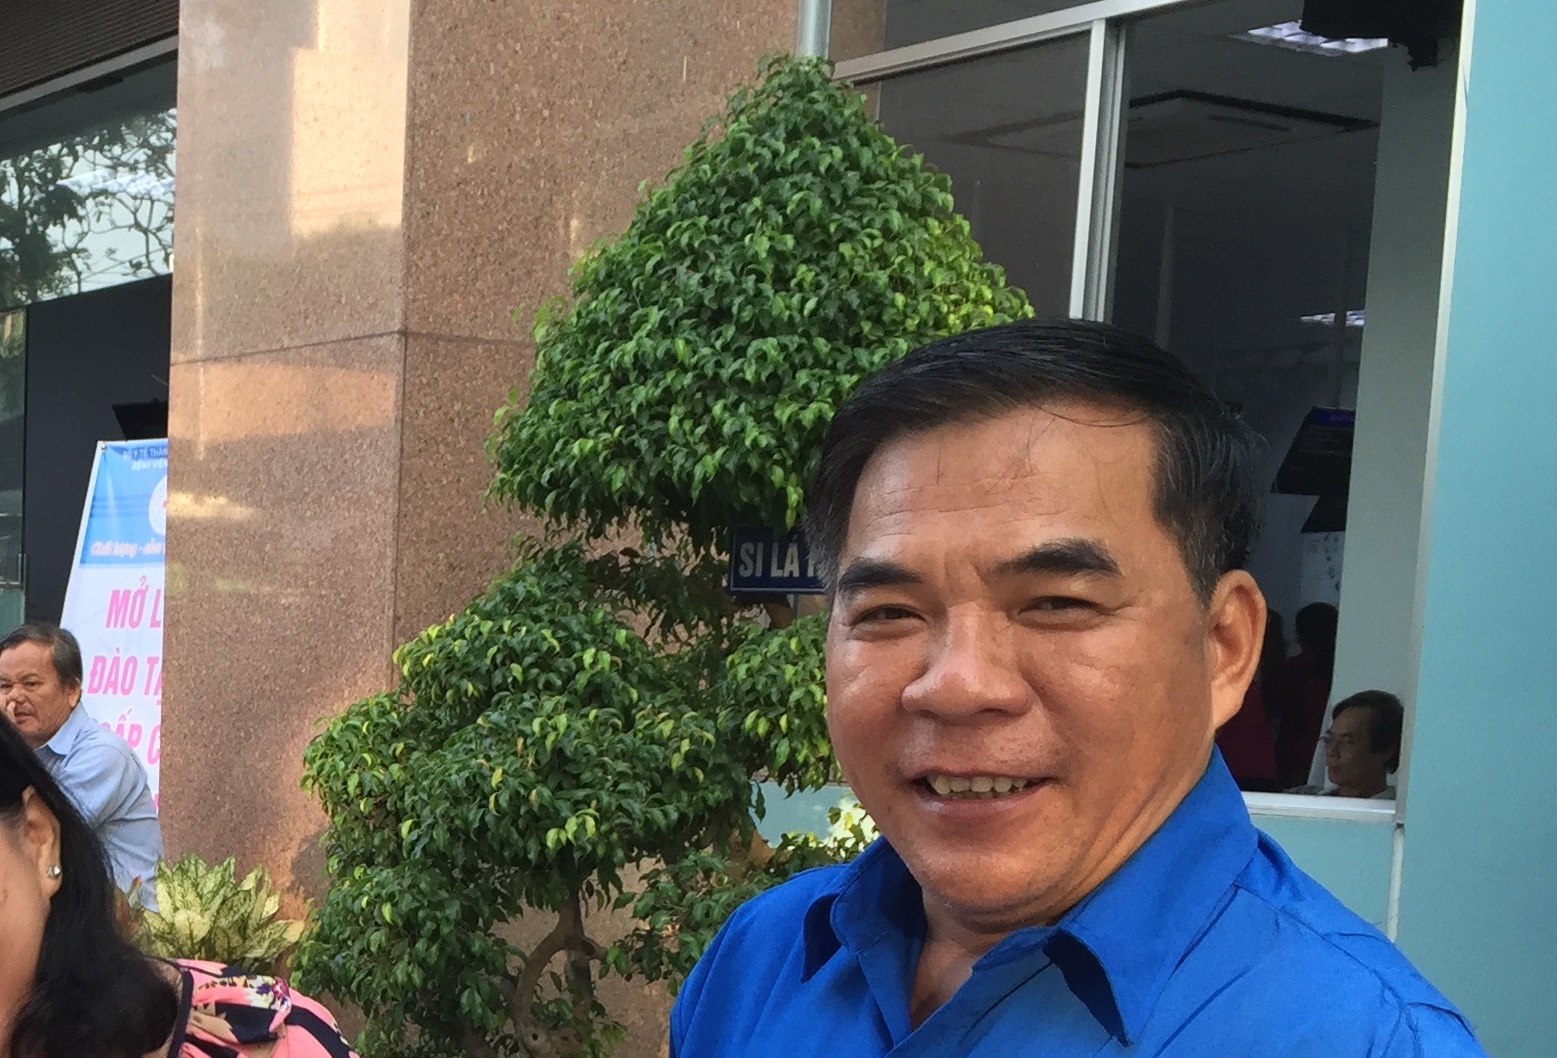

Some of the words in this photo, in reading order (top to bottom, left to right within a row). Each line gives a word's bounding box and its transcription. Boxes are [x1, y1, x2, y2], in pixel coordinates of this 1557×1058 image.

[738, 541, 765, 578] SI
[105, 575, 148, 629] MỞ
[149, 588, 162, 628] L
[143, 656, 163, 706] TẠ
[100, 708, 143, 750] ẤP
[146, 724, 161, 766] C
